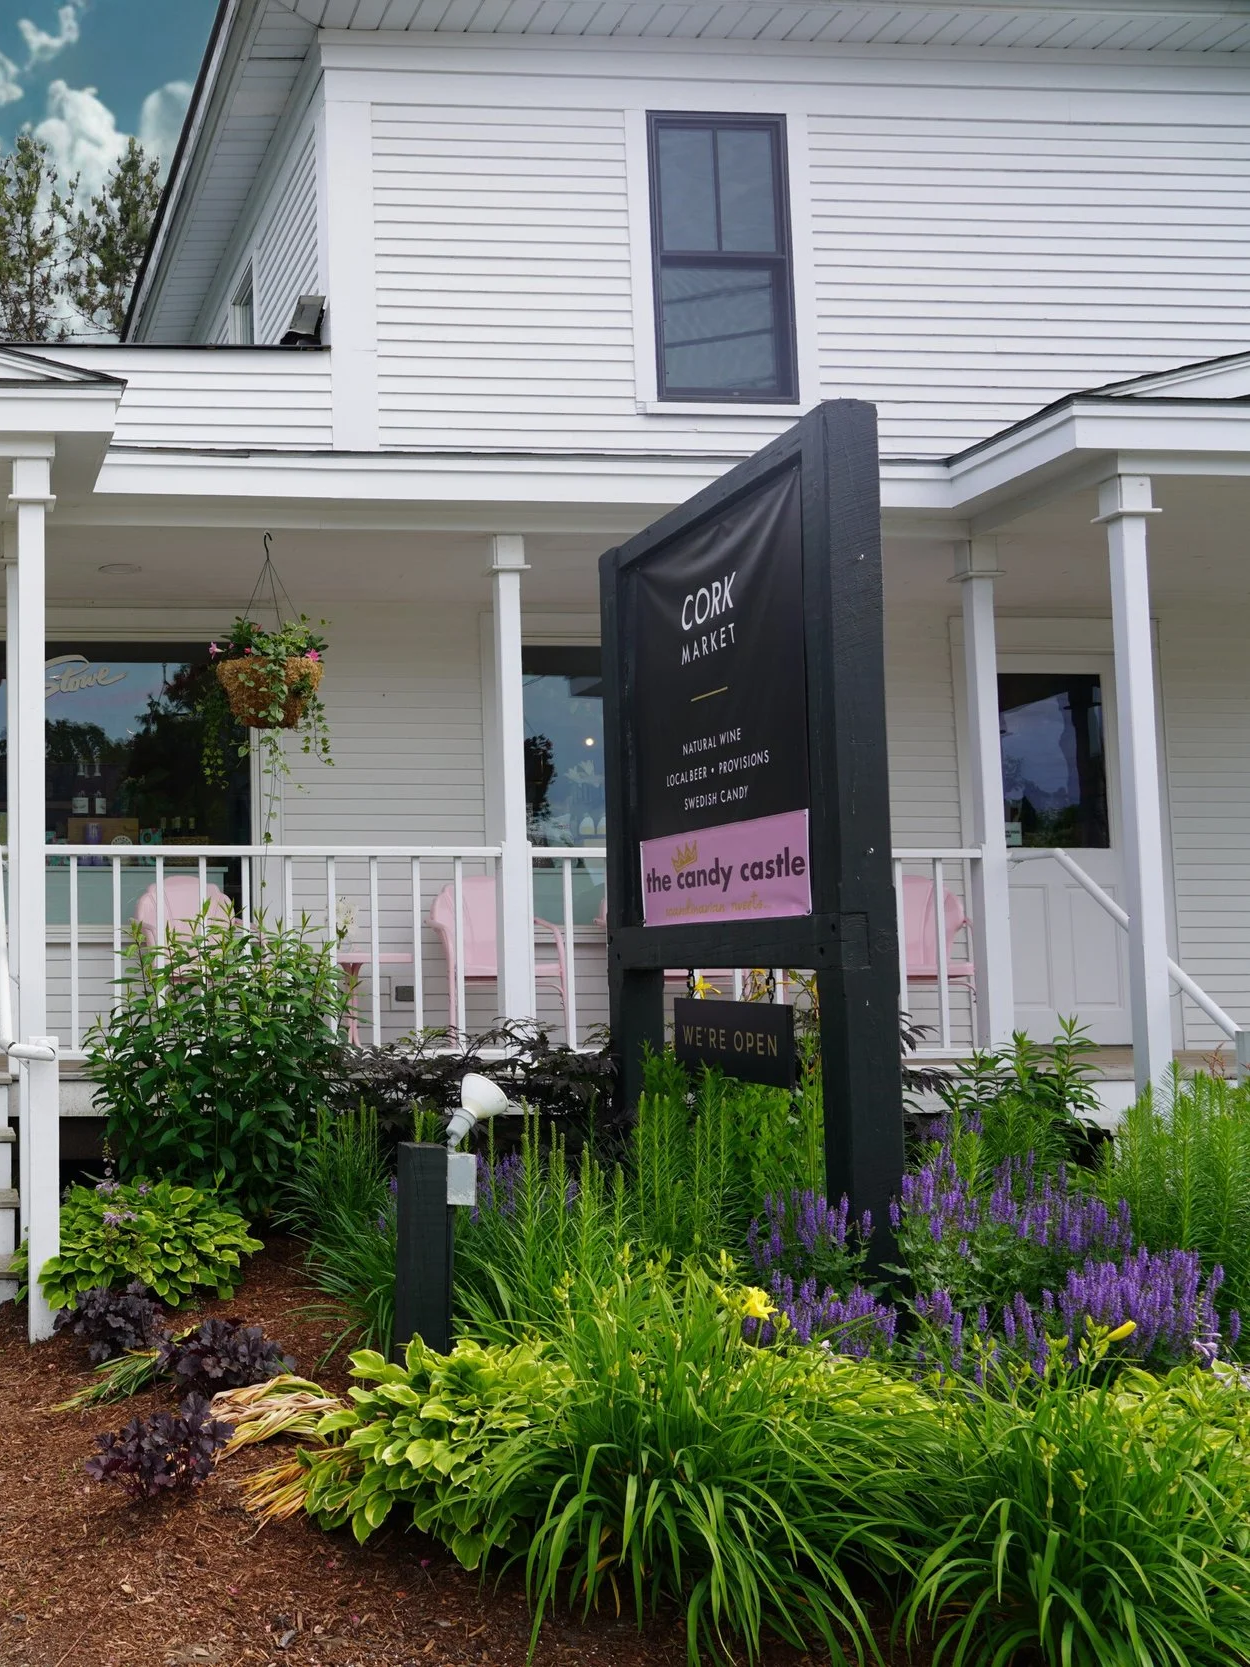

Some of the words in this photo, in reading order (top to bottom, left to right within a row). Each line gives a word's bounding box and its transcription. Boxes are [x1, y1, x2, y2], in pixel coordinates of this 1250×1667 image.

[681, 571, 737, 631] CORK
[681, 622, 735, 666] MARKET
[682, 735, 717, 756] NATURAL
[719, 727, 742, 746] WINE
[718, 749, 770, 775] PROVISIONS
[684, 792, 718, 811] SWEDISH
[720, 785, 749, 804] CANDY
[646, 868, 672, 894] the
[677, 857, 734, 893] candy
[740, 846, 806, 883] castle
[682, 1025, 727, 1050] WE'RE
[733, 1030, 778, 1057] OPEN
